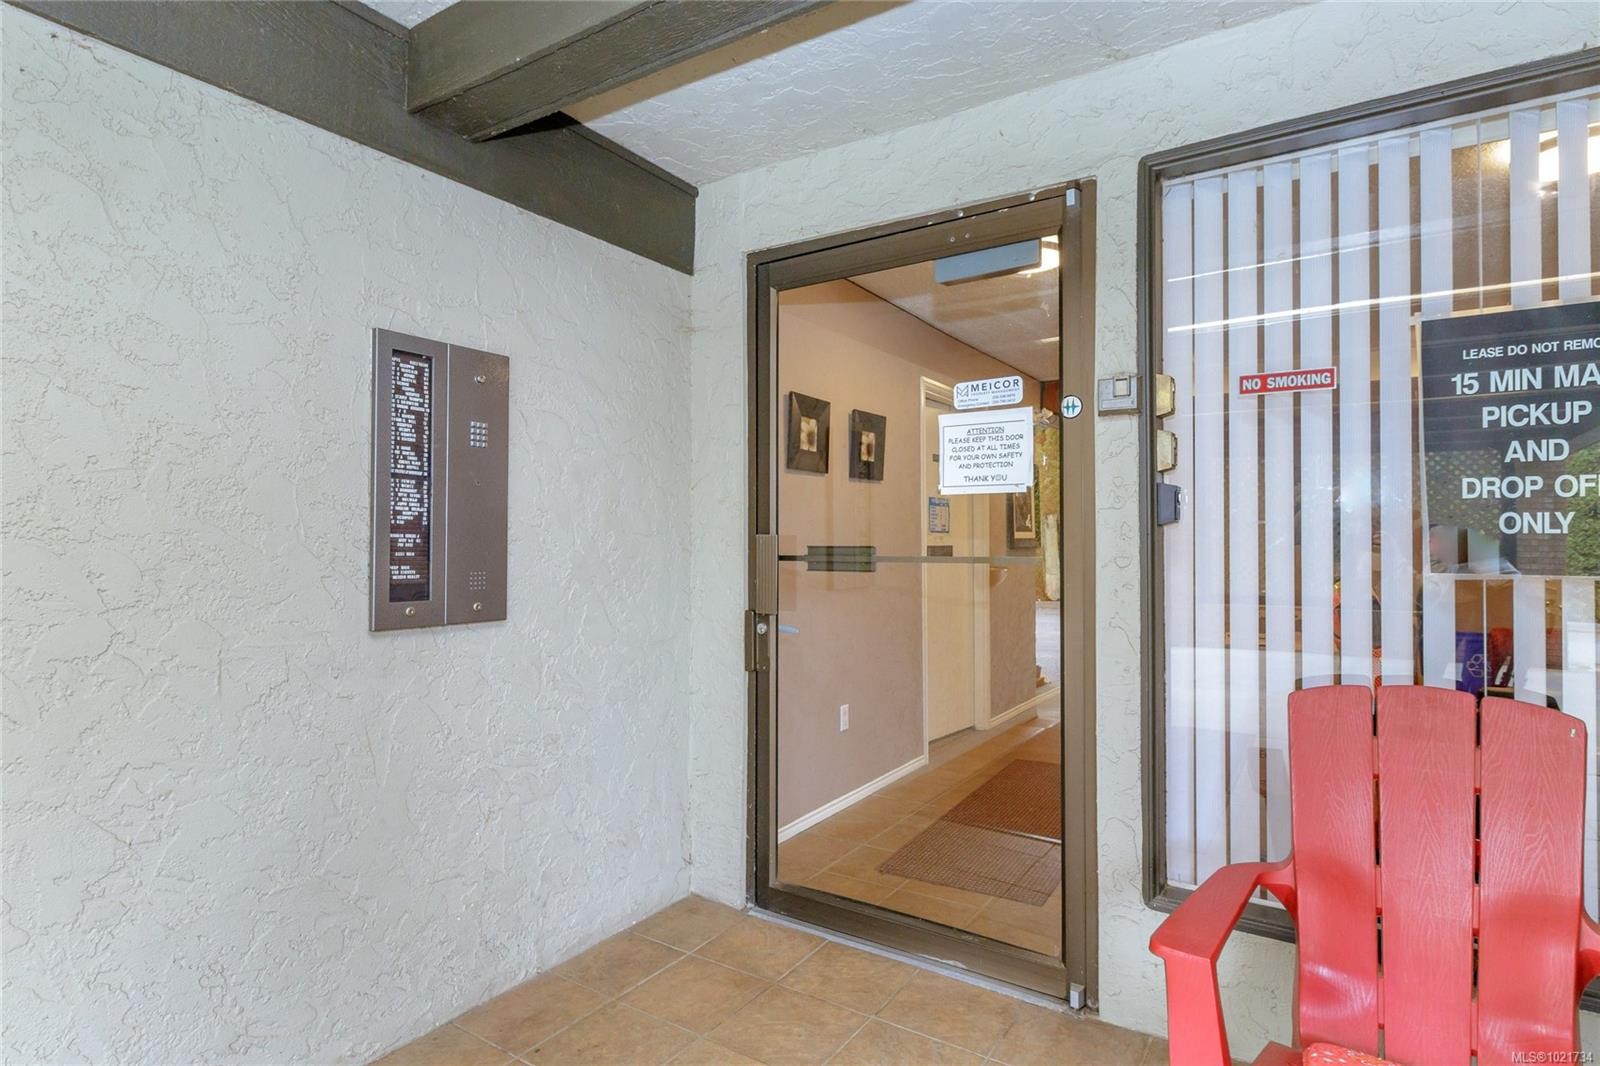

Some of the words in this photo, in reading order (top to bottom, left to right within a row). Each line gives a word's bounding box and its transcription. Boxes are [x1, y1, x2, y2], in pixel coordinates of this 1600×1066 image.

[1462, 346, 1504, 360] LEASE
[1507, 344, 1528, 357] DO
[1531, 341, 1560, 354] NOT
[970, 379, 1020, 392] MEICOR
[1242, 379, 1262, 391] NO
[1266, 372, 1332, 389] SMOKING
[1450, 371, 1480, 395] 15
[1489, 368, 1542, 393] MIN
[1482, 400, 1593, 429] PICKUP
[966, 425, 1005, 435] ATTENTION
[1006, 433, 1024, 441] DOOR
[963, 453, 979, 461] YOUR
[981, 452, 997, 460] OWN
[998, 451, 1023, 459] SAFETY
[1504, 438, 1570, 463] AND
[973, 461, 1014, 469] PROTECTION
[963, 475, 989, 483] THANK
[990, 474, 1008, 482] YOU
[1461, 475, 1544, 500] DROP
[1554, 473, 1600, 498] OF
[1498, 511, 1576, 535] ONLY
